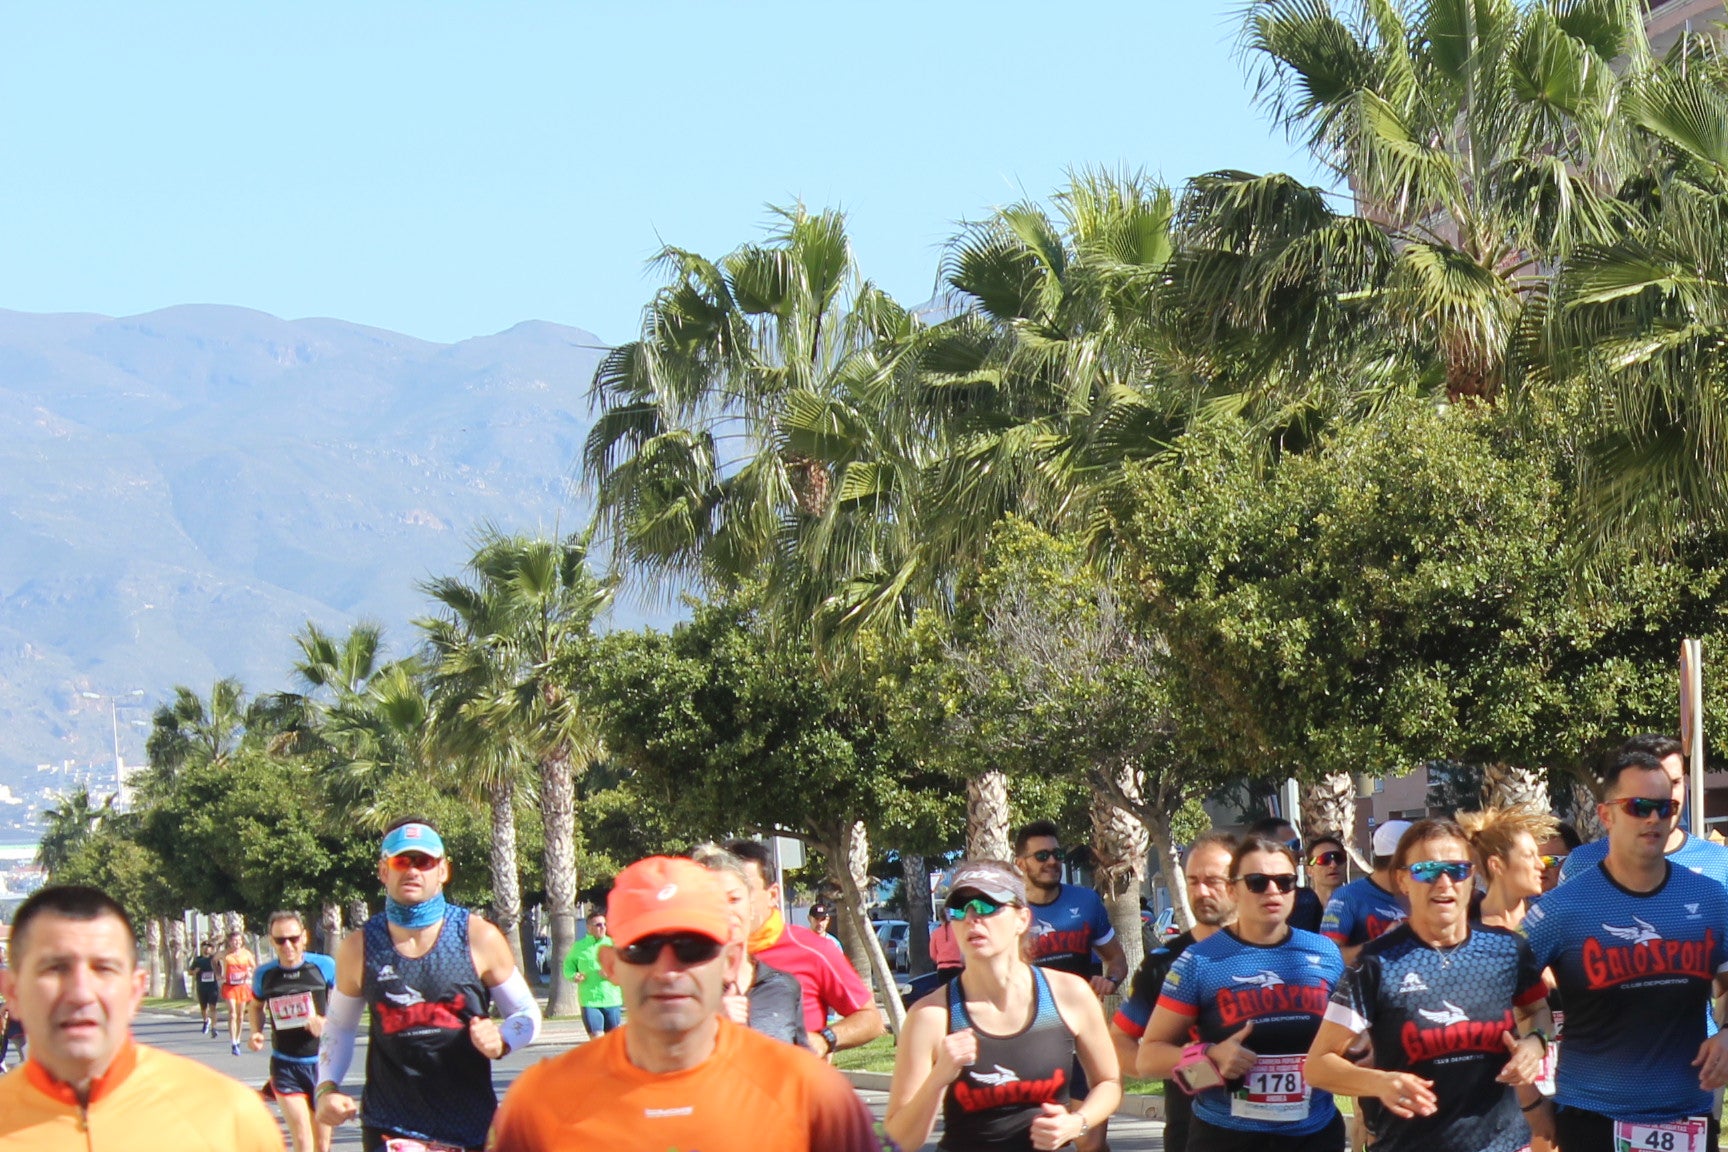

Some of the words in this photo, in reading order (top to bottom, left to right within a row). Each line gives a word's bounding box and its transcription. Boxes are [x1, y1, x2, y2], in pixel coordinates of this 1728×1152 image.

[1646, 978, 1689, 988] DEPORTIVO
[1257, 1073, 1296, 1093] 178
[1645, 1130, 1674, 1151] 48
